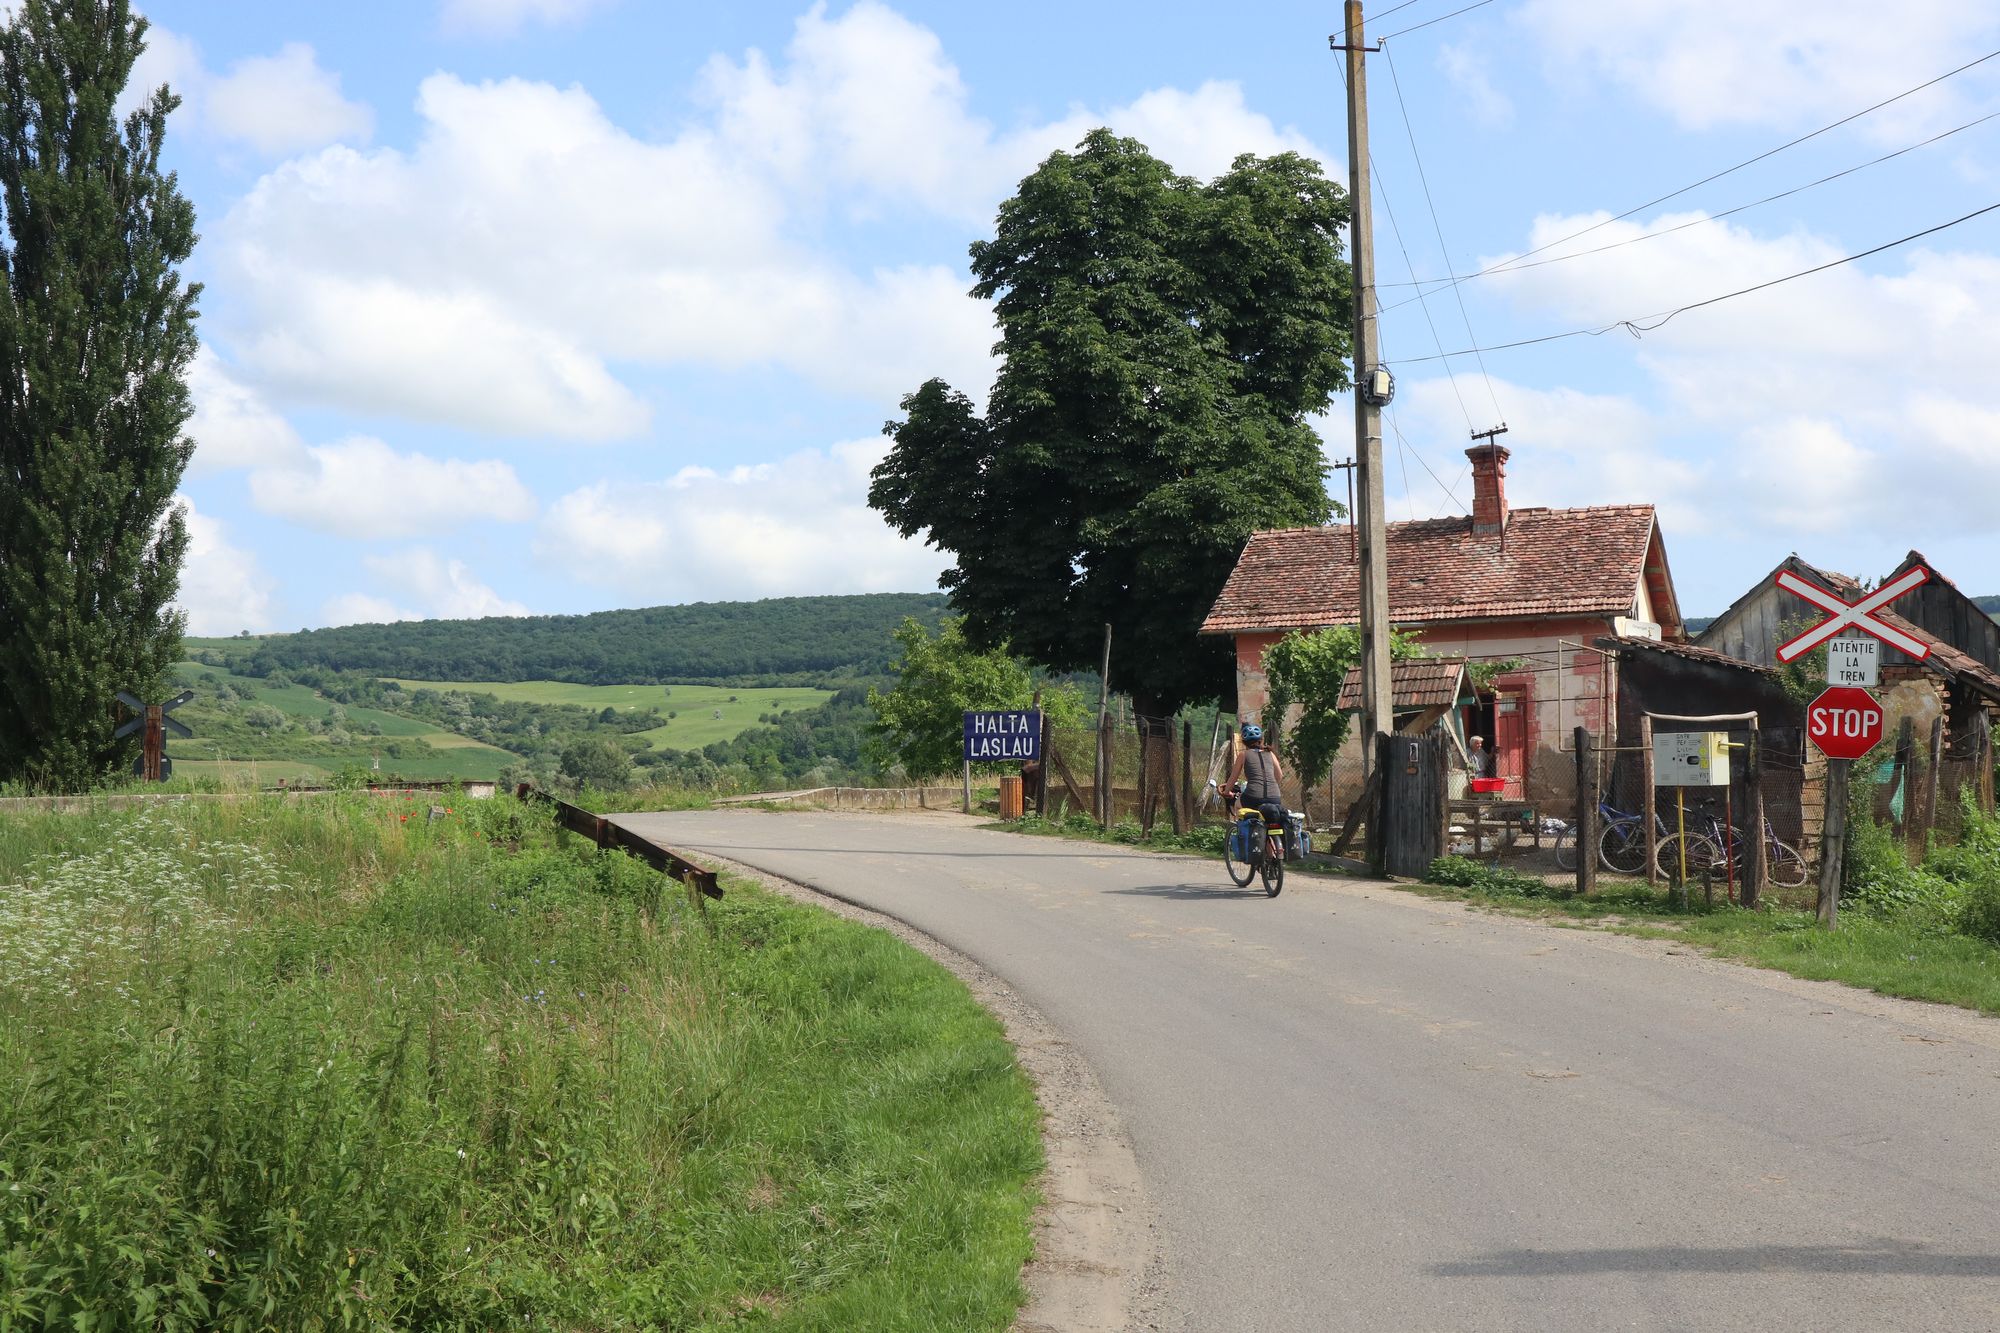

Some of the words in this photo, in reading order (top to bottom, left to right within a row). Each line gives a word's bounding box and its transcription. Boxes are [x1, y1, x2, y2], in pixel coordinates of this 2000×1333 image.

[1846, 657, 1859, 667] LA
[1839, 671, 1865, 681] TREN
[975, 715, 1028, 733] HALTA
[1811, 708, 1879, 737] STOP
[970, 737, 1033, 757] LASLAU
